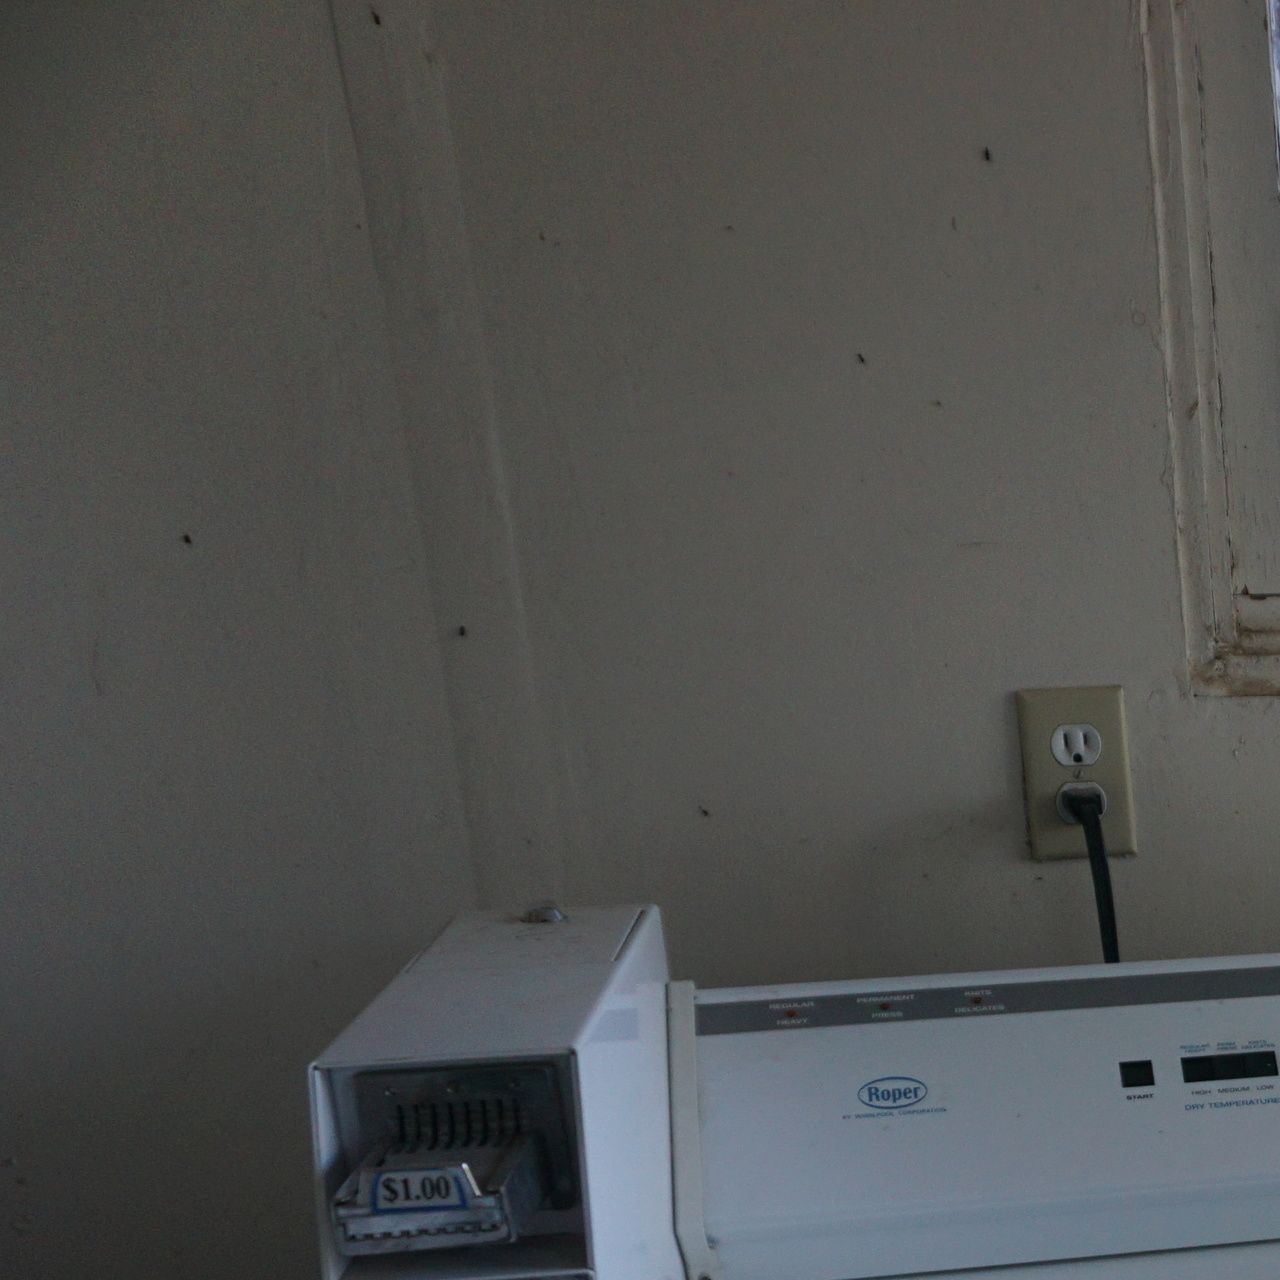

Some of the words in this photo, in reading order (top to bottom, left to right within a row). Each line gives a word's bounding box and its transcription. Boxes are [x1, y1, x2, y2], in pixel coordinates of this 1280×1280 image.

[856, 994, 915, 1003] PERMANENT
[769, 1001, 815, 1010] REGULAR
[776, 1017, 809, 1026] HEAVY
[867, 1084, 922, 1103] Roper
[1217, 1086, 1250, 1094] MEDIUM
[1126, 1093, 1155, 1101] START
[1184, 1103, 1205, 1112] DRY
[382, 1176, 450, 1202] $1.00
